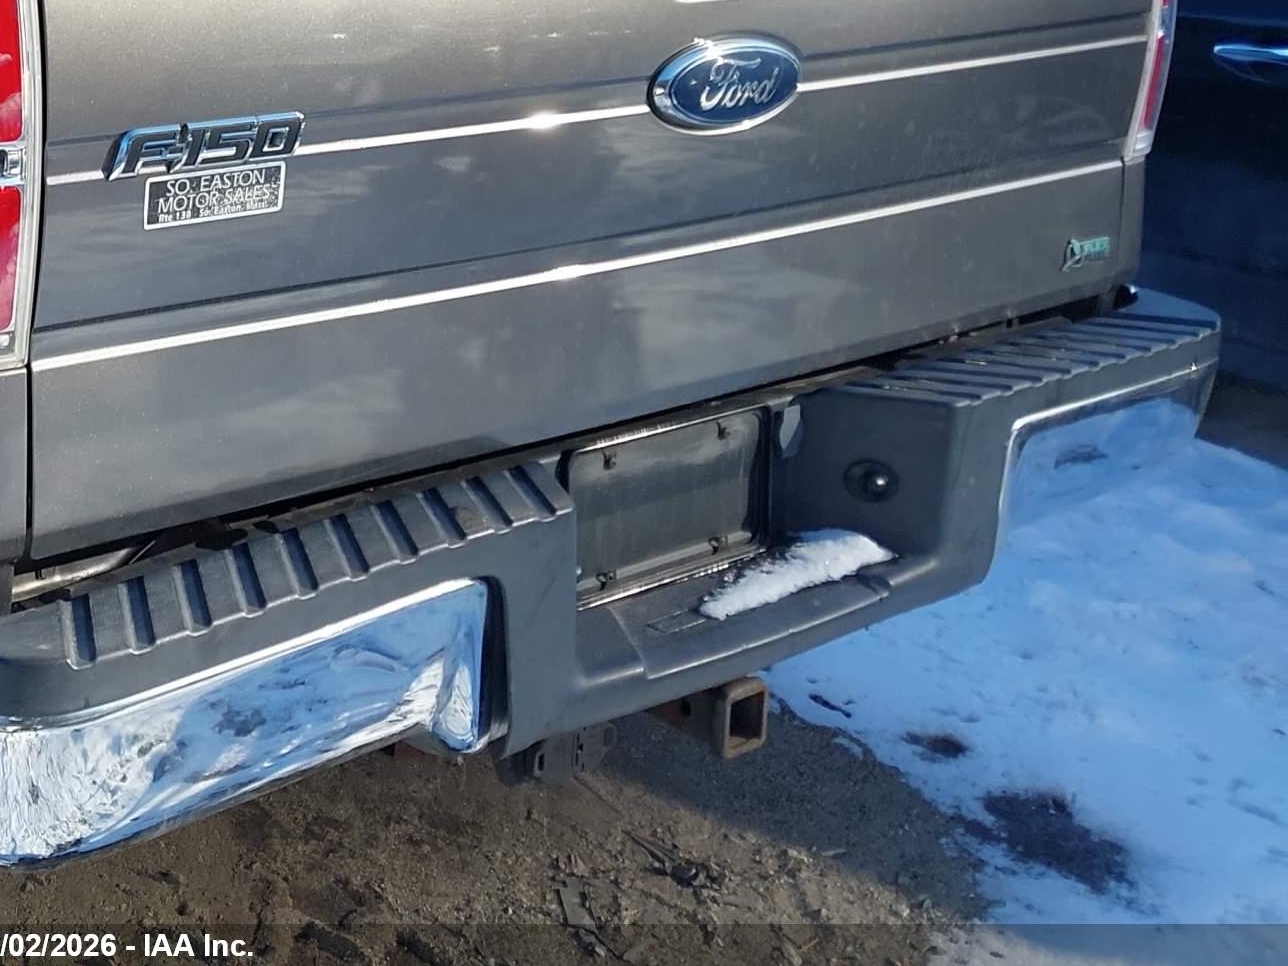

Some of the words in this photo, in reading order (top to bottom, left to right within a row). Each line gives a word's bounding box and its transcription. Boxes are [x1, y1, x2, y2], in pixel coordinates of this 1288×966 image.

[699, 56, 780, 112] Ford
[157, 191, 219, 214] MOTOR
[223, 183, 272, 205] SALES
[166, 178, 193, 197] SO.
[200, 169, 266, 192] EASTON
